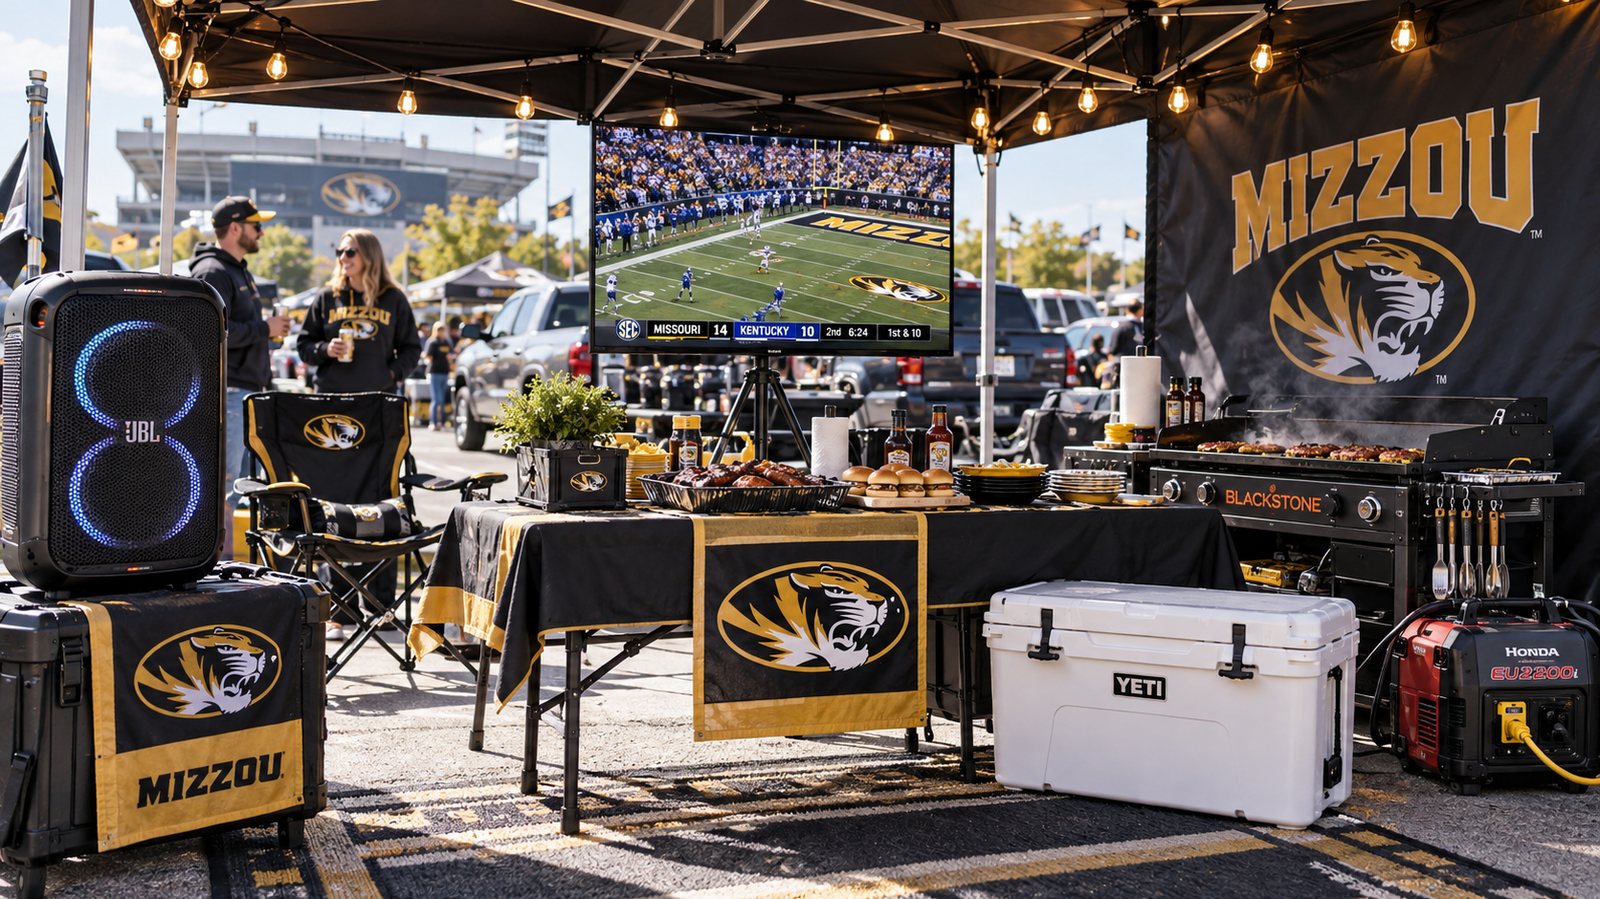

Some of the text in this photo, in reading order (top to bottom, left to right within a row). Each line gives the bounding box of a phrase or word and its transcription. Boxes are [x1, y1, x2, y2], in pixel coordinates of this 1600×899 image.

[1231, 97, 1541, 275] MIZZOU
[1530, 229, 1543, 239] TM
[327, 305, 392, 326] MIZZOU
[618, 320, 638, 339] SEC
[653, 324, 728, 336] MISSOURI 14
[740, 325, 815, 337] KENTUCKY 10
[826, 327, 868, 337] 2nd 6:24
[887, 328, 922, 338] 1st & 10
[1435, 374, 1447, 384] TM
[125, 420, 161, 443] JBL
[1225, 489, 1322, 513] BLACKSTONE
[1505, 647, 1560, 657] HONDA
[1490, 665, 1579, 680] EU2200i
[1116, 676, 1162, 697] YETI
[136, 751, 283, 809] MIZZOU
